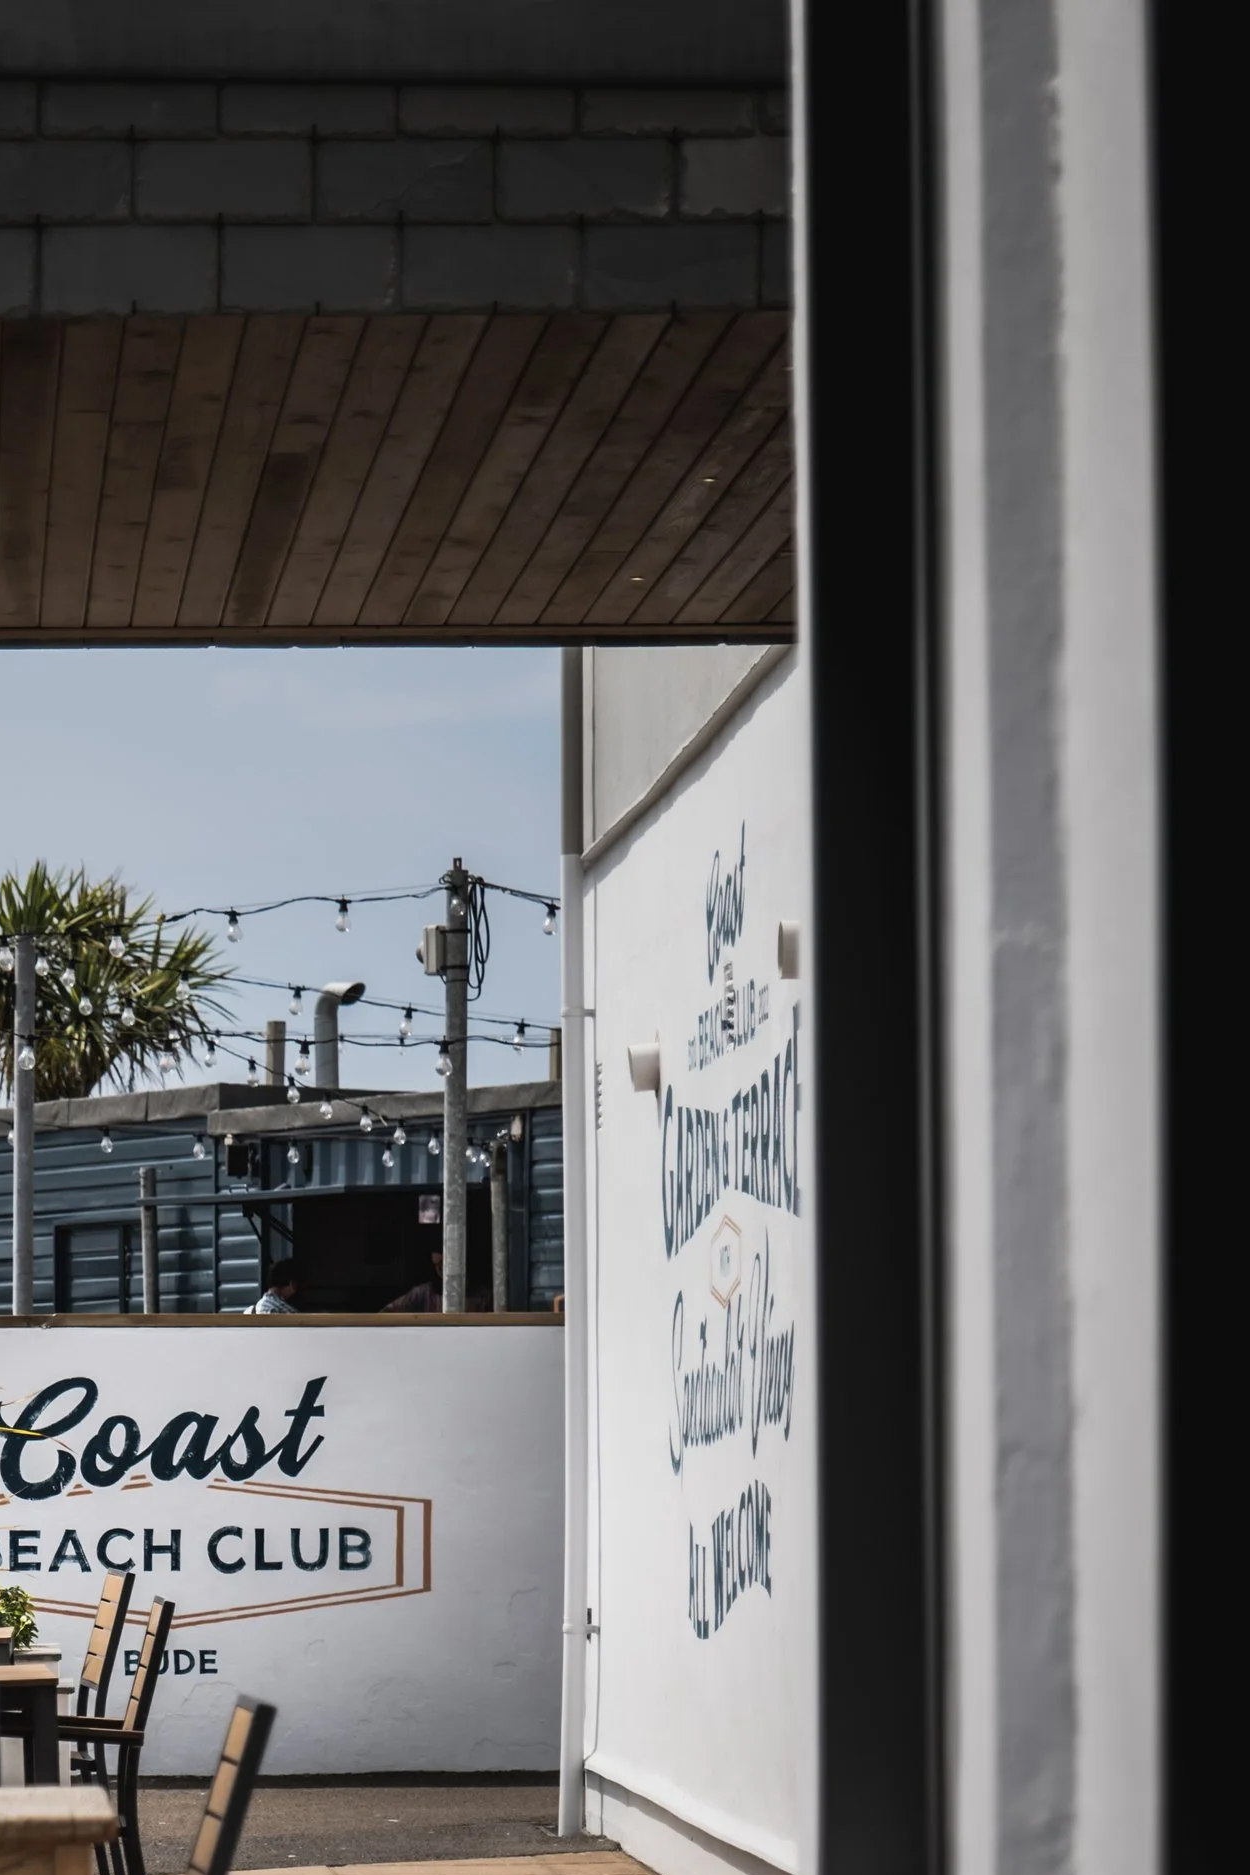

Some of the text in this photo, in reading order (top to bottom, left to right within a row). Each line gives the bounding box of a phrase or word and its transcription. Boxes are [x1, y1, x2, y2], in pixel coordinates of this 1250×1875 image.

[706, 820, 746, 986] Coast
[662, 1000, 801, 1260] GARDEN & TERRACE
[669, 1225, 795, 1492] Spectacular Views
[207, 1525, 373, 1575] CLUB
[688, 1479, 772, 1641] ALL WELCOME
